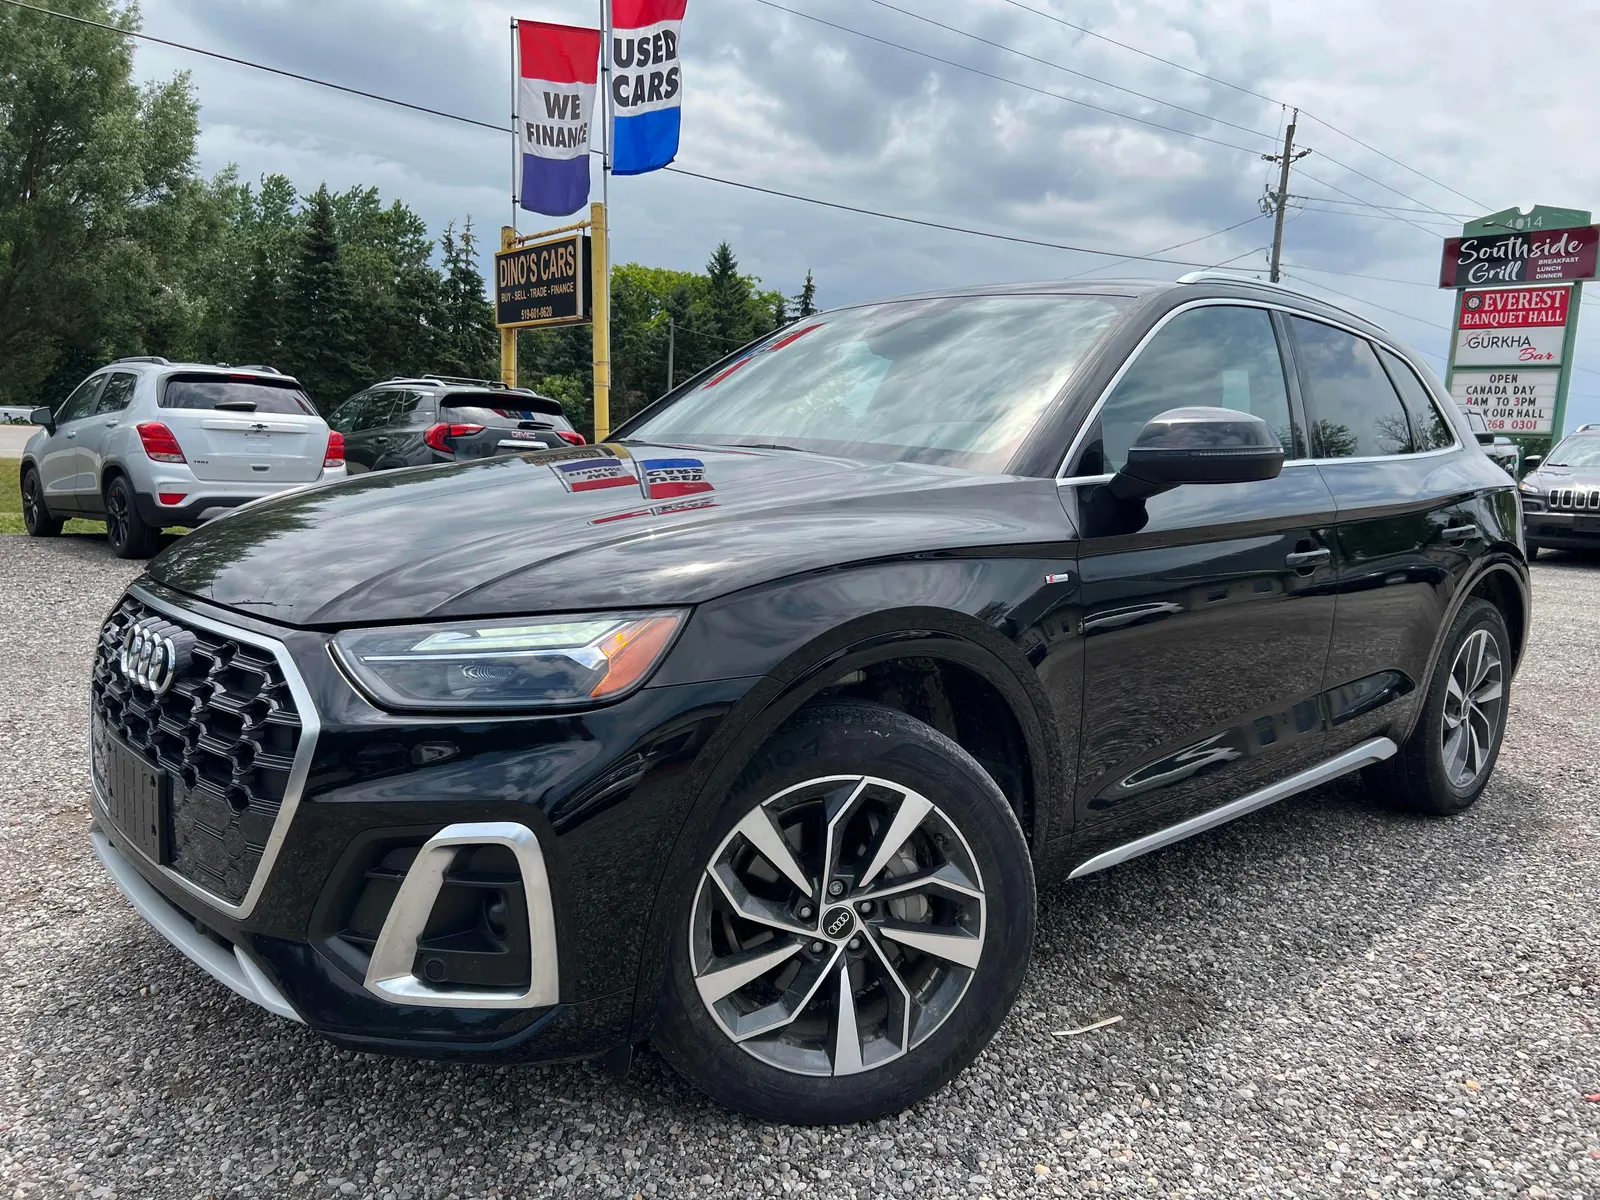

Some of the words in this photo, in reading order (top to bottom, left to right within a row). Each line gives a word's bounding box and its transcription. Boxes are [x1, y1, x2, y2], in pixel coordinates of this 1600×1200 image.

[613, 29, 677, 68] USED
[612, 66, 679, 107] CARS
[543, 91, 581, 120] WE
[1505, 216, 1543, 229] 4014
[1457, 233, 1583, 265] Southside
[500, 253, 538, 287] DINO'S
[540, 245, 575, 281] CARS
[1538, 257, 1579, 265] BREAKFAST
[1468, 261, 1522, 283] Grill
[501, 293, 511, 303] BUY
[514, 290, 527, 300] SELL
[530, 286, 547, 297] TRADE
[550, 282, 574, 295] FINANCE
[1484, 290, 1565, 311] EVEREST
[1463, 312, 1525, 326] BANQUET
[1528, 310, 1563, 322] HALL
[1468, 335, 1532, 349] GURKHA
[1518, 347, 1556, 361] Bar
[1489, 374, 1518, 384] OPEN
[1466, 386, 1507, 395] CANADA
[1513, 386, 1536, 395] DAY
[1466, 396, 1489, 406] 8AM
[1496, 397, 1509, 406] TO
[1513, 397, 1536, 406] 3PM
[1492, 409, 1514, 418] OUR
[1516, 409, 1544, 418] HALL
[1511, 420, 1537, 430] 0301
[511, 431, 536, 439] GMC
